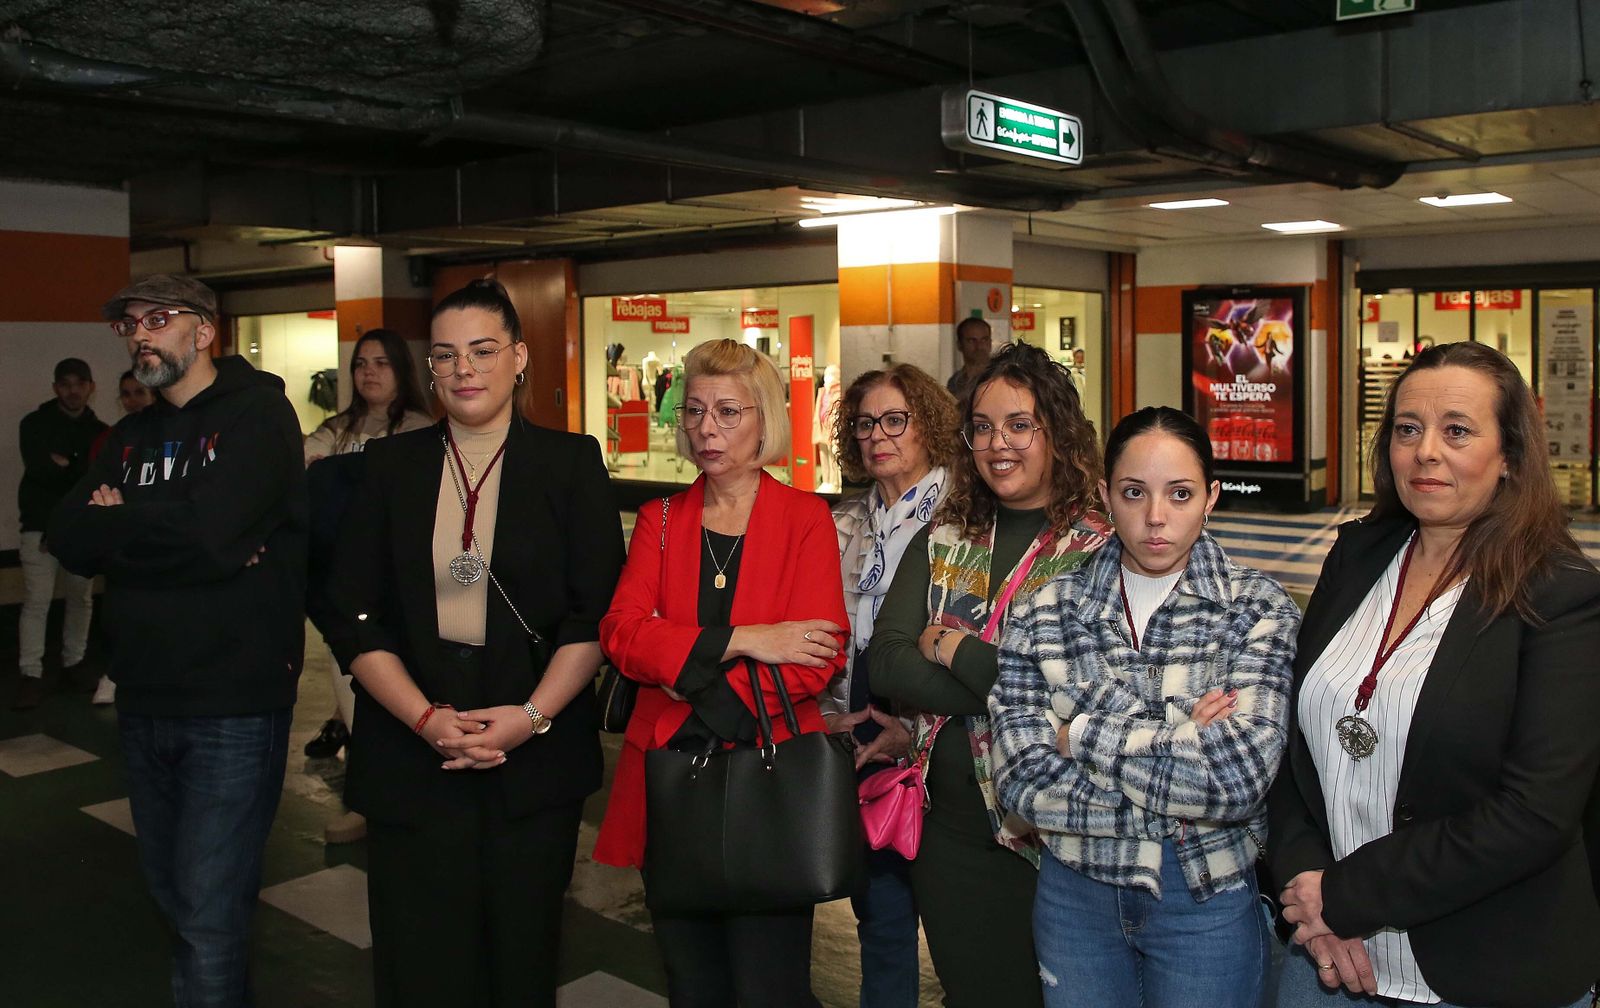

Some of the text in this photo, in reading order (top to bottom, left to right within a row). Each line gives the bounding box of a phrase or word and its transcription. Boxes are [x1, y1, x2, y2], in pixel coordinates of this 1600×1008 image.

[617, 300, 662, 319] rebajas
[1235, 374, 1249, 383] EL
[1209, 383, 1276, 393] MULTIVERSO
[1214, 392, 1272, 401] TE ESPERA
